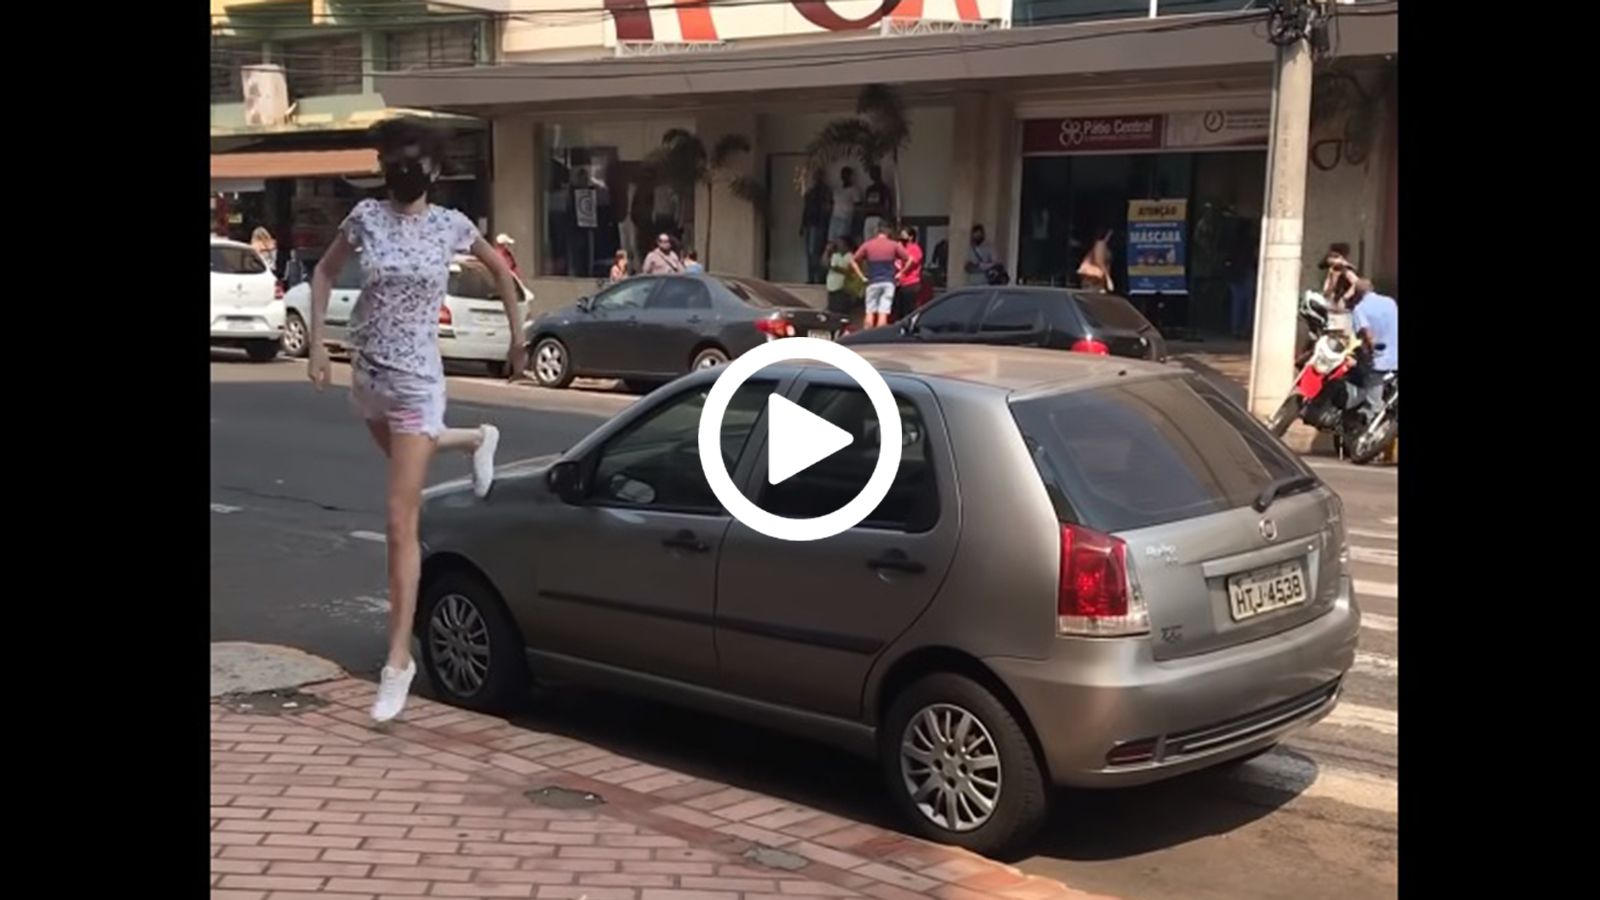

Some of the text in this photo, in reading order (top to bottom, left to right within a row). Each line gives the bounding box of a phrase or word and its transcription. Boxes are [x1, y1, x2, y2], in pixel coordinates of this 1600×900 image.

[1114, 118, 1154, 133] Central
[1137, 205, 1177, 217] ATENÇÃO
[1129, 228, 1182, 243] MÁSCARA
